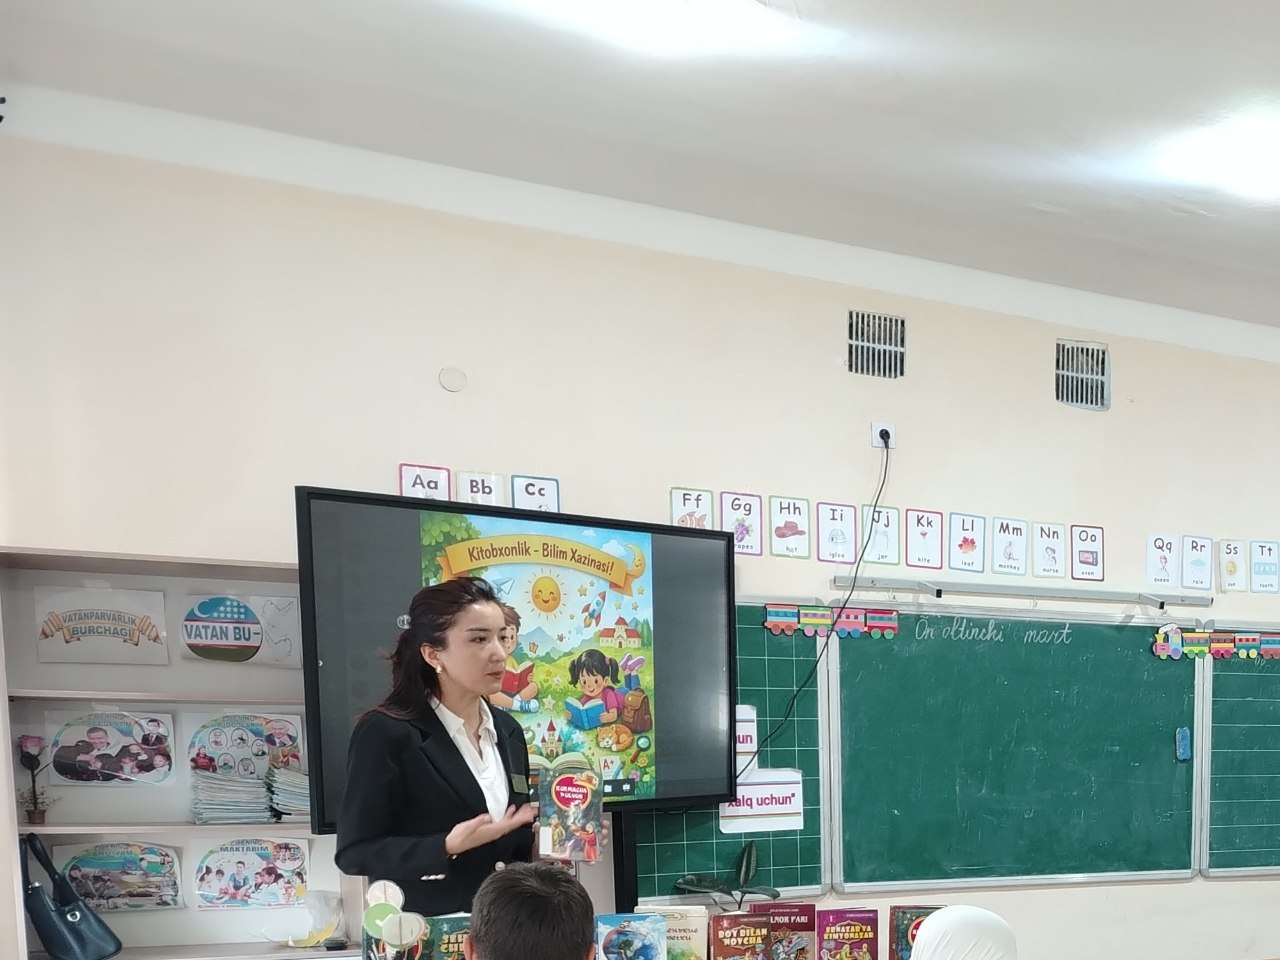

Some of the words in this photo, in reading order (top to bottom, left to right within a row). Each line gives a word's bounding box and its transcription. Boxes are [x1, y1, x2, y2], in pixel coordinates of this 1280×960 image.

[411, 473, 439, 491] Aa
[469, 478, 493, 496] Bb
[524, 482, 546, 498] Cc
[682, 492, 702, 509] Ff
[731, 497, 752, 516] Gg
[779, 501, 802, 516] Hh
[829, 508, 844, 522] Ii
[873, 509, 890, 528] Jj
[916, 514, 933, 529] Kk
[998, 521, 1023, 537] Mm
[1039, 525, 1059, 540] Nn
[1078, 529, 1097, 543] Oo
[734, 542, 753, 551] rapes
[1153, 537, 1172, 554] Qq
[1191, 540, 1206, 552] Rr
[1225, 543, 1238, 555] Ss
[1258, 545, 1273, 557] Tt
[467, 541, 531, 563] Kitobxonlik
[542, 542, 568, 561] Bilim
[569, 551, 615, 576] Xazinasi!
[917, 556, 931, 564] kite
[998, 563, 1021, 571] monkey
[61, 611, 137, 627] VATANPARVARLIK
[71, 626, 132, 638] BURCHAGI
[184, 624, 230, 641] VATAN
[1023, 623, 1072, 645] mart
[790, 915, 808, 923] PARI
[740, 928, 768, 937] BILAN
[724, 936, 762, 946] NOVCHA
